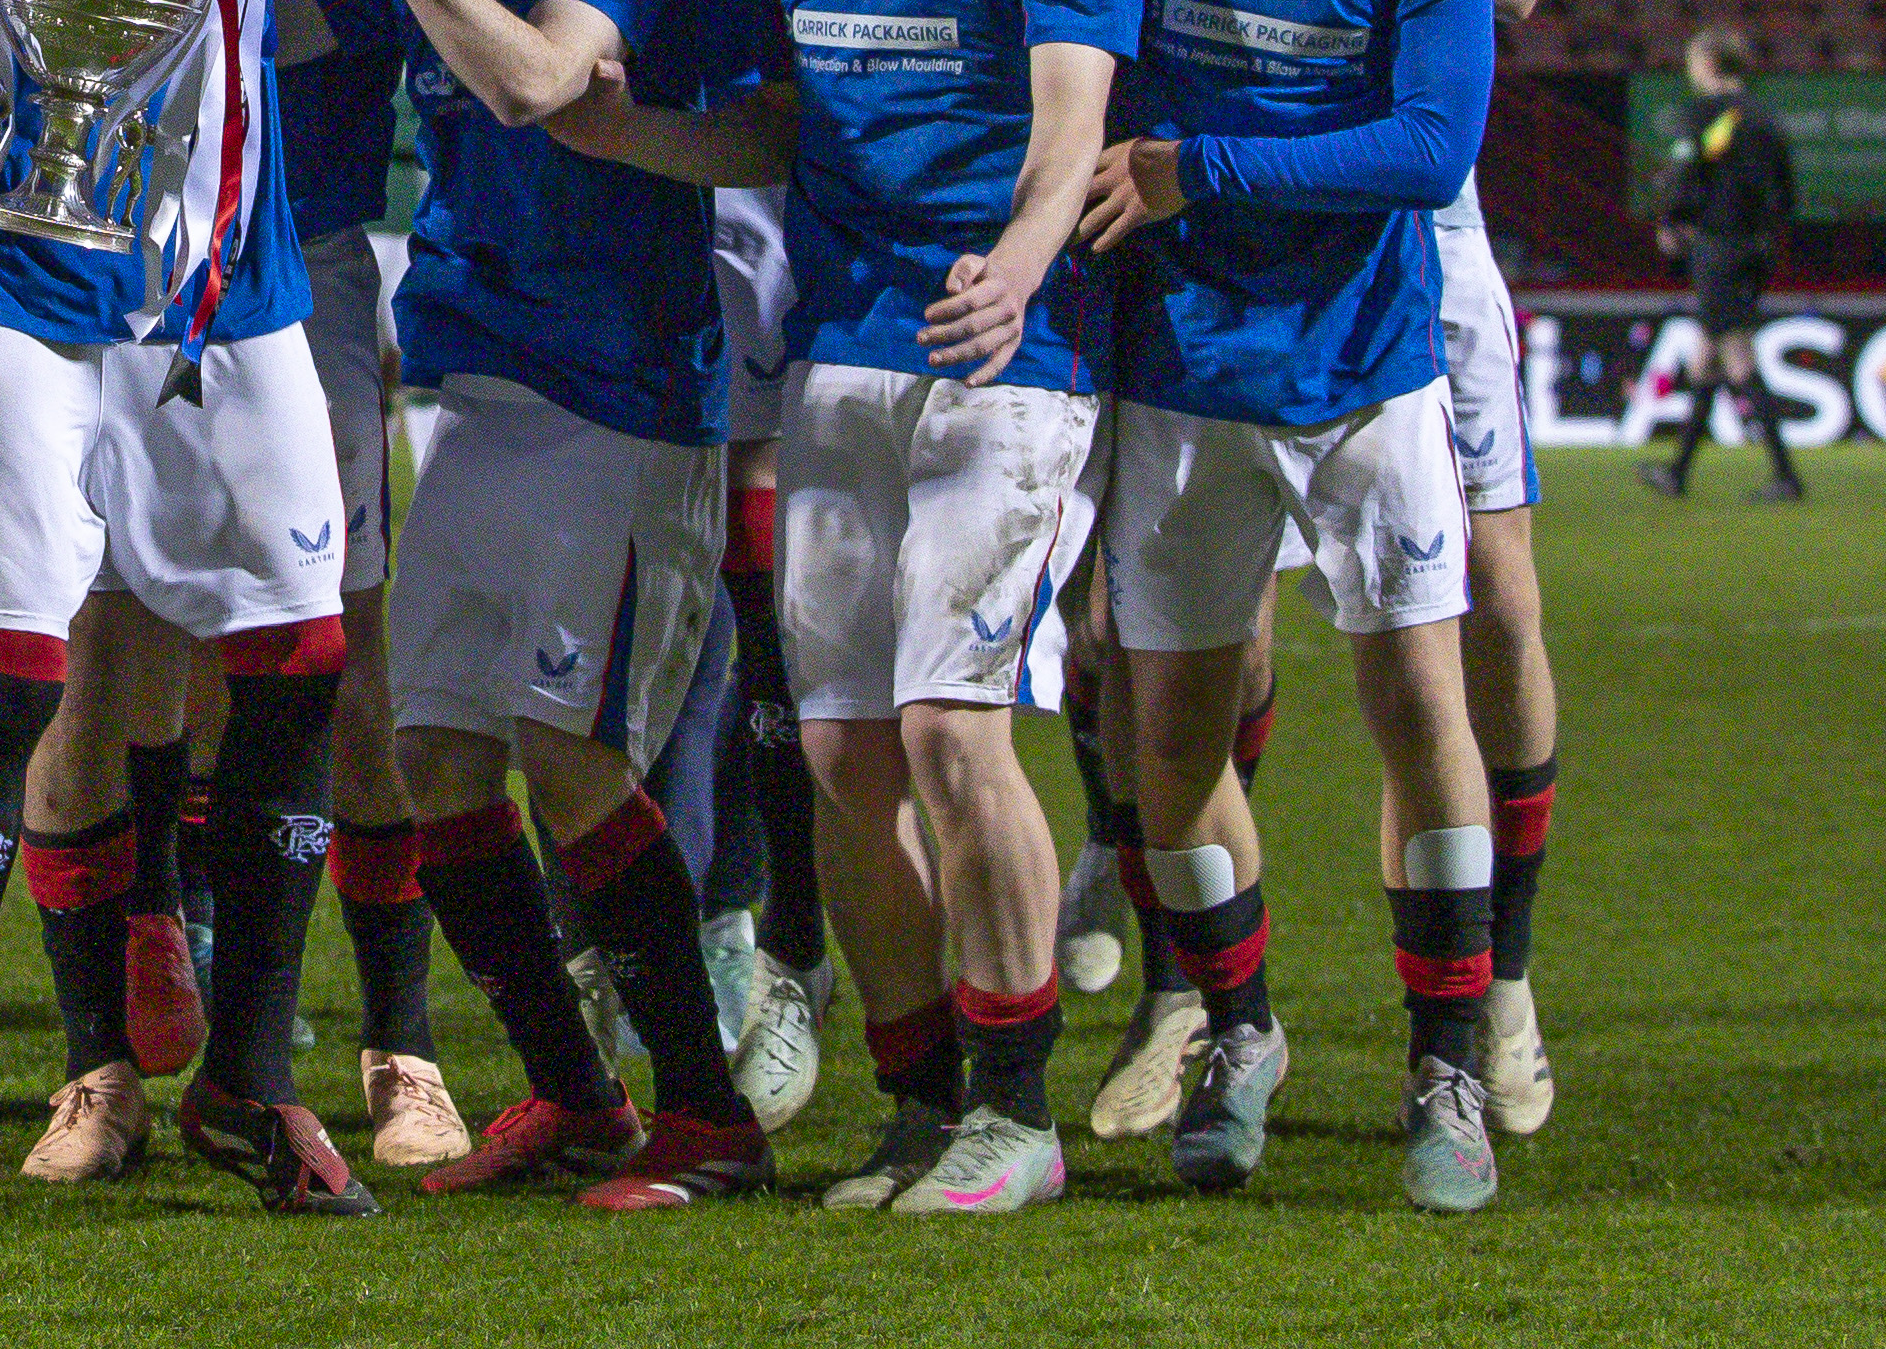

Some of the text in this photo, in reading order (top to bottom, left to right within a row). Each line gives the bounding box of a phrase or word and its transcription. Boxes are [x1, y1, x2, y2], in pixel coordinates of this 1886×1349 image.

[796, 18, 953, 43] CARRICK PACKAGING
[1173, 7, 1365, 50] CARRICK PACKAGING
[901, 57, 964, 76] Moulding
